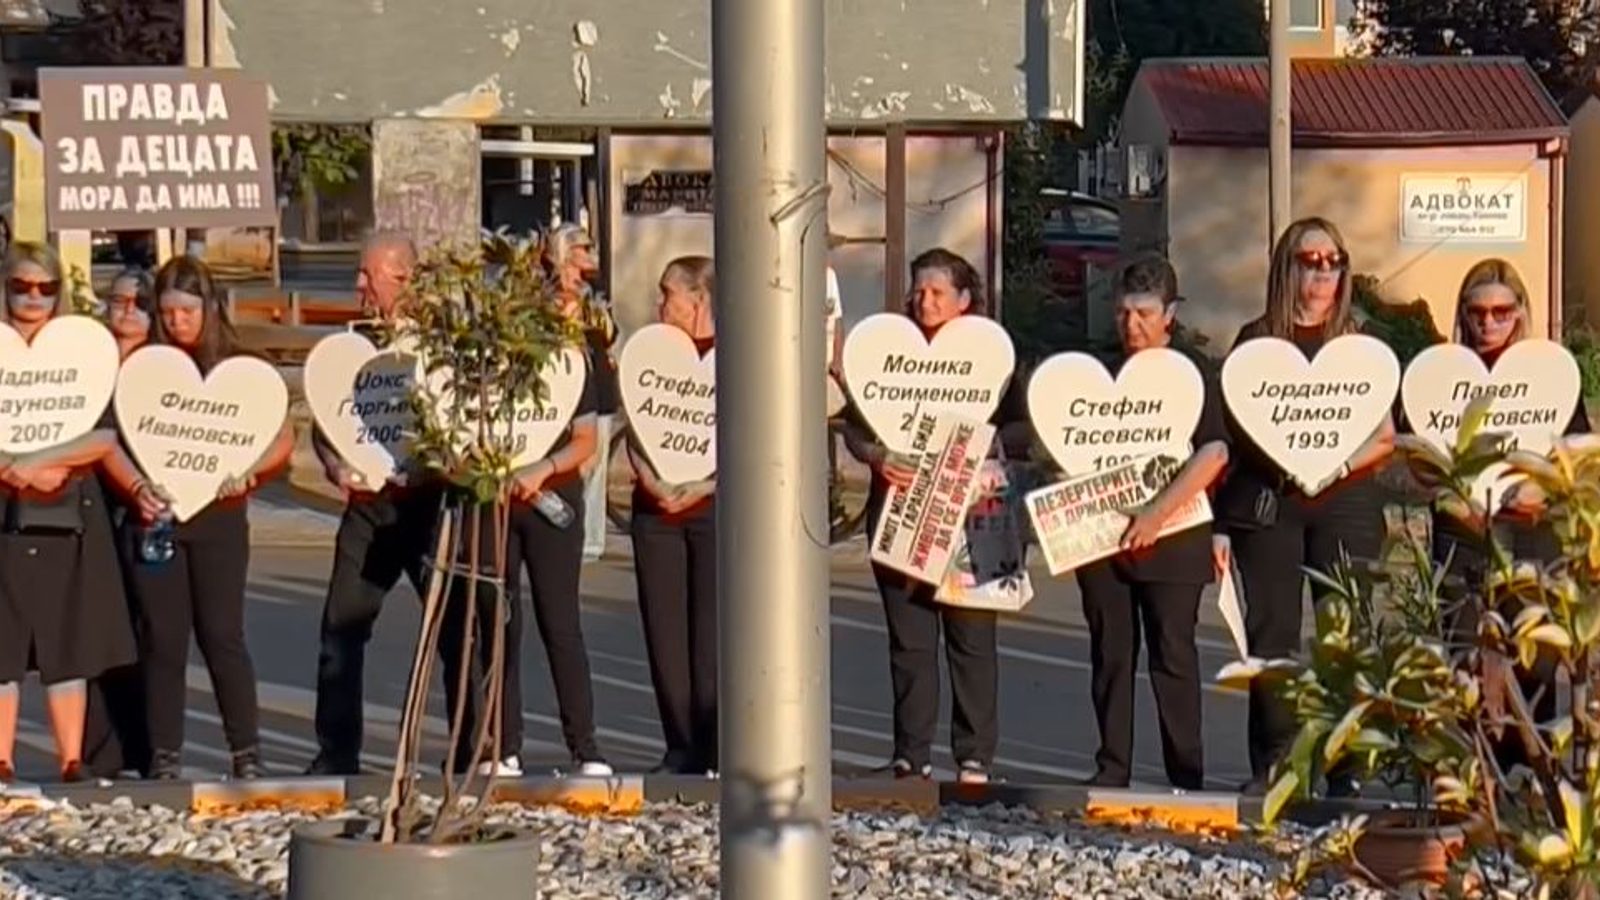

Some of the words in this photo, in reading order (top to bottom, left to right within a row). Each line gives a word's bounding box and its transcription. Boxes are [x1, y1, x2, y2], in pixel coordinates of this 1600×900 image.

[82, 83, 228, 125] ПРАВДА
[58, 136, 105, 173] ЗА
[116, 134, 257, 177] ДЕЦАТА
[60, 185, 128, 211] МОРА
[135, 185, 172, 213] ДА
[177, 184, 230, 209] ИМА
[236, 184, 260, 209] !!!
[1410, 193, 1514, 212] АДВОКАТ
[882, 354, 973, 376] Моника
[862, 380, 992, 404] Стоименова
[1252, 382, 1372, 401] Јорданчо
[1451, 381, 1529, 402] Павел
[160, 391, 240, 418] Филип
[1069, 396, 1163, 420] Стефан
[1270, 403, 1352, 427] Џамов
[10, 421, 64, 444] 2007
[137, 415, 255, 446] Ивановски
[1061, 426, 1171, 446] Тасевски
[1286, 430, 1340, 450] 1993
[659, 430, 712, 456] 2004
[944, 422, 976, 472] МОЖЕ
[164, 450, 219, 473] 2008
[876, 516, 901, 554] ИМОТ
[911, 412, 938, 452] БИДЕ
[936, 473, 957, 497] НЕ
[1033, 463, 1142, 517] ДЕЗЕРТЕРИТЕ
[942, 504, 962, 528] СЕ
[1064, 484, 1148, 526] ДРЖАВАТА
[908, 495, 948, 571] ЖИВОТОТ
[933, 526, 955, 553] ДА
